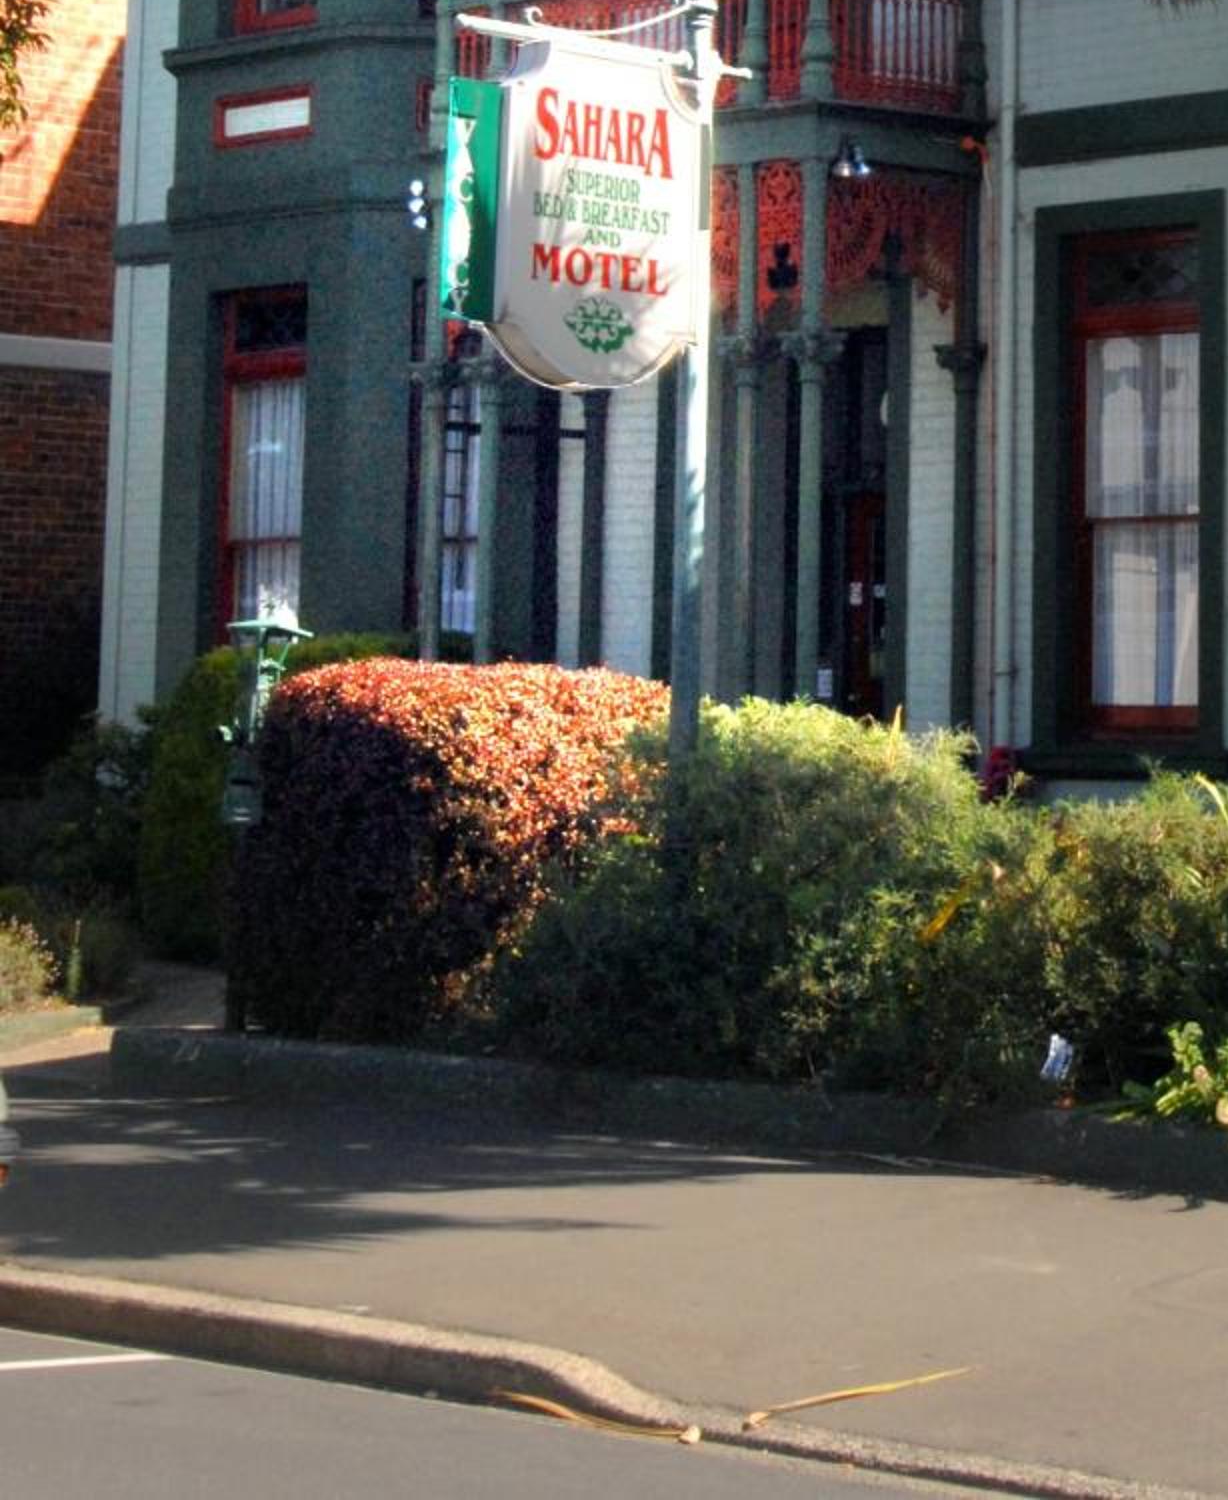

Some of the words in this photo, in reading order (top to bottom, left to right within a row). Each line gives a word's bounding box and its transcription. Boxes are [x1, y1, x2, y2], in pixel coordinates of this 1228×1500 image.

[534, 86, 673, 180] SAHARA
[566, 168, 641, 204] SUPERIOR
[533, 190, 563, 219] BED
[564, 196, 577, 222] &
[581, 199, 671, 235] BREAKFAST
[582, 228, 621, 248] AND
[531, 243, 669, 297] MOTEL
